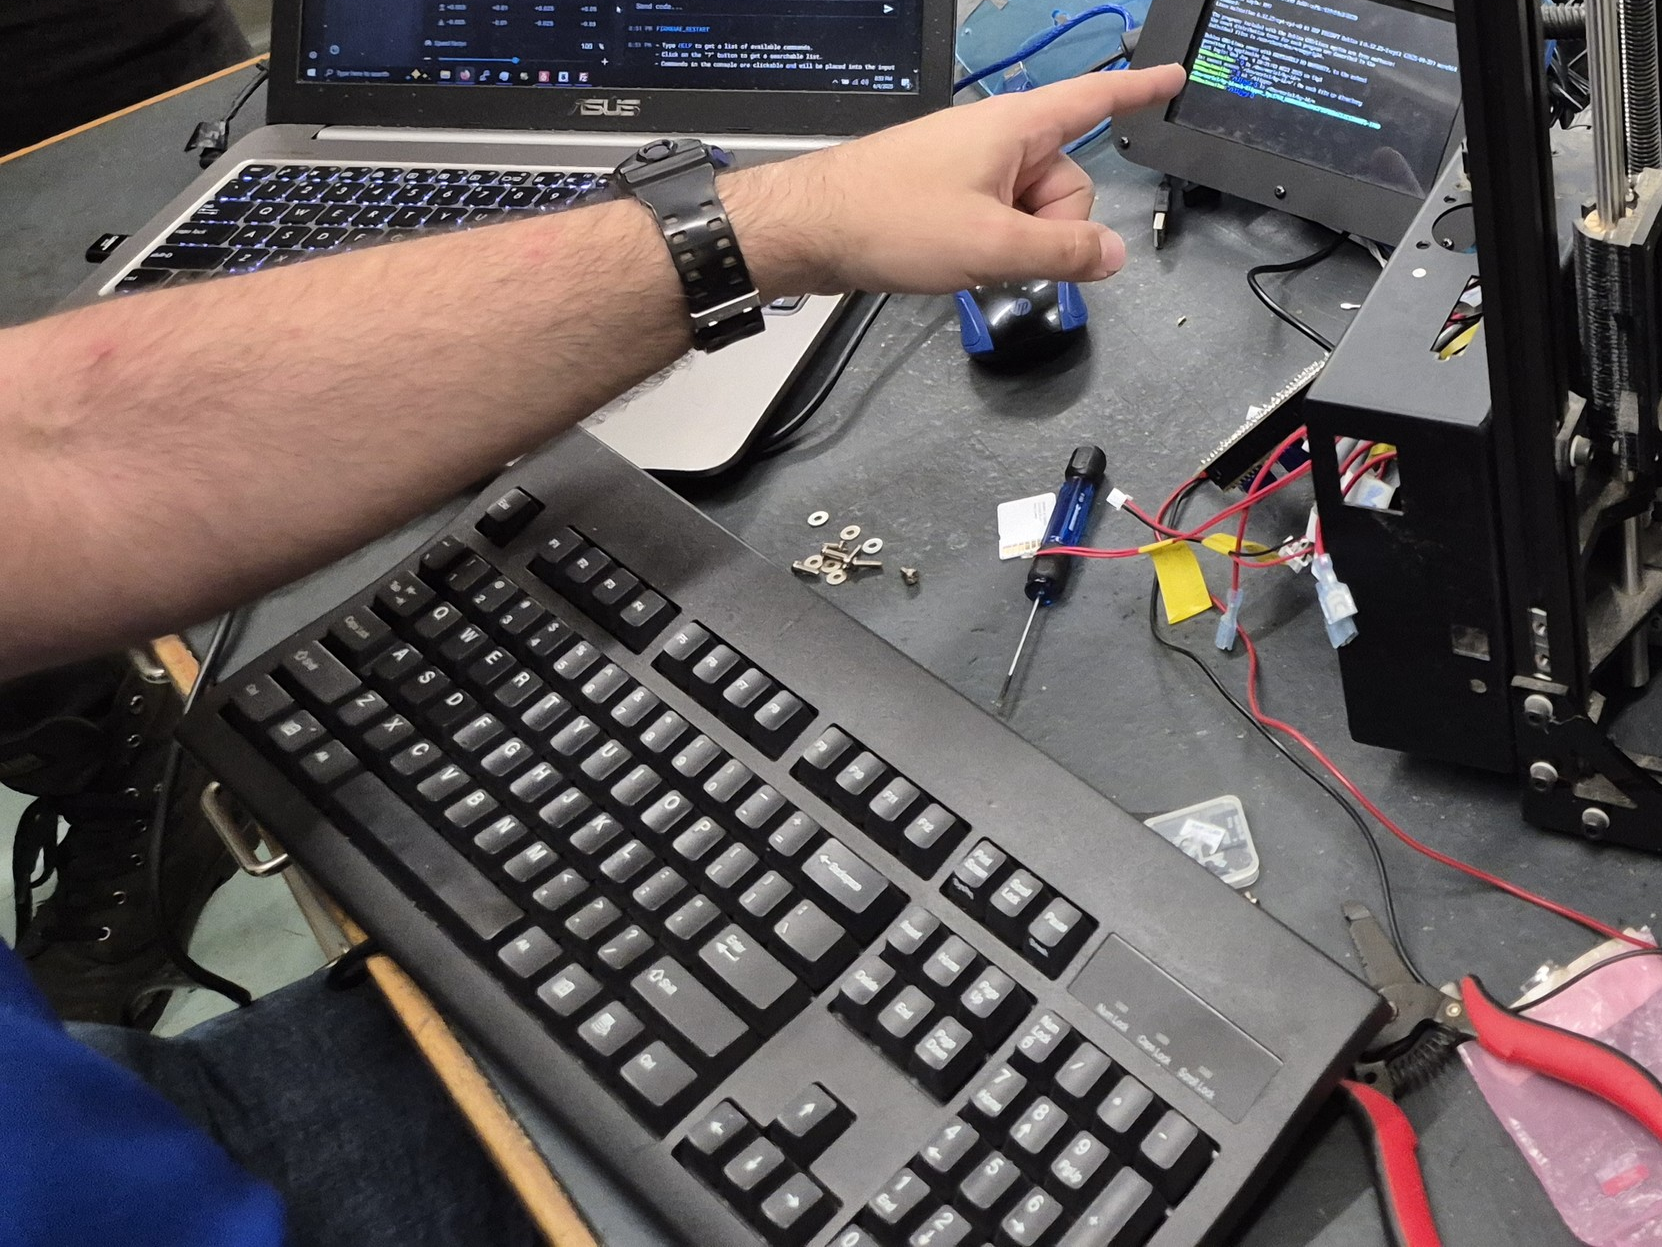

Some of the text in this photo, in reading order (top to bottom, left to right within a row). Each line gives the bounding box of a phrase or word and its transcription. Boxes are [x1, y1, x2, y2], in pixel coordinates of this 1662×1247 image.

[572, 98, 641, 116] ASUS
[433, 606, 449, 621] Q
[459, 629, 479, 643] W
[392, 647, 410, 661] A
[485, 650, 503, 665] E
[418, 670, 436, 684] S
[512, 671, 530, 688] R
[355, 695, 376, 708] Z
[445, 692, 464, 707] D
[544, 695, 561, 710] T
[383, 718, 403, 732] X
[473, 717, 492, 730] F
[572, 719, 590, 734] Y
[411, 742, 430, 756] C
[504, 741, 521, 757] G
[601, 742, 619, 757] U
[440, 768, 459, 781] V
[532, 765, 552, 781] H
[632, 769, 645, 780] I
[466, 791, 486, 807] B
[562, 792, 580, 803] J
[664, 795, 681, 810] O
[496, 817, 516, 834] N
[590, 815, 611, 831] K
[694, 820, 711, 833] P
[525, 845, 548, 862] M
[622, 842, 637, 858] L
[993, 1068, 1012, 1083] 7
[1033, 1103, 1049, 1121] 8
[944, 1124, 962, 1140] 4
[1075, 1138, 1091, 1155] 9
[985, 1156, 1004, 1175] 5
[895, 1175, 912, 1192] 1
[1027, 1194, 1045, 1212] 6
[933, 1212, 954, 1231] 2
